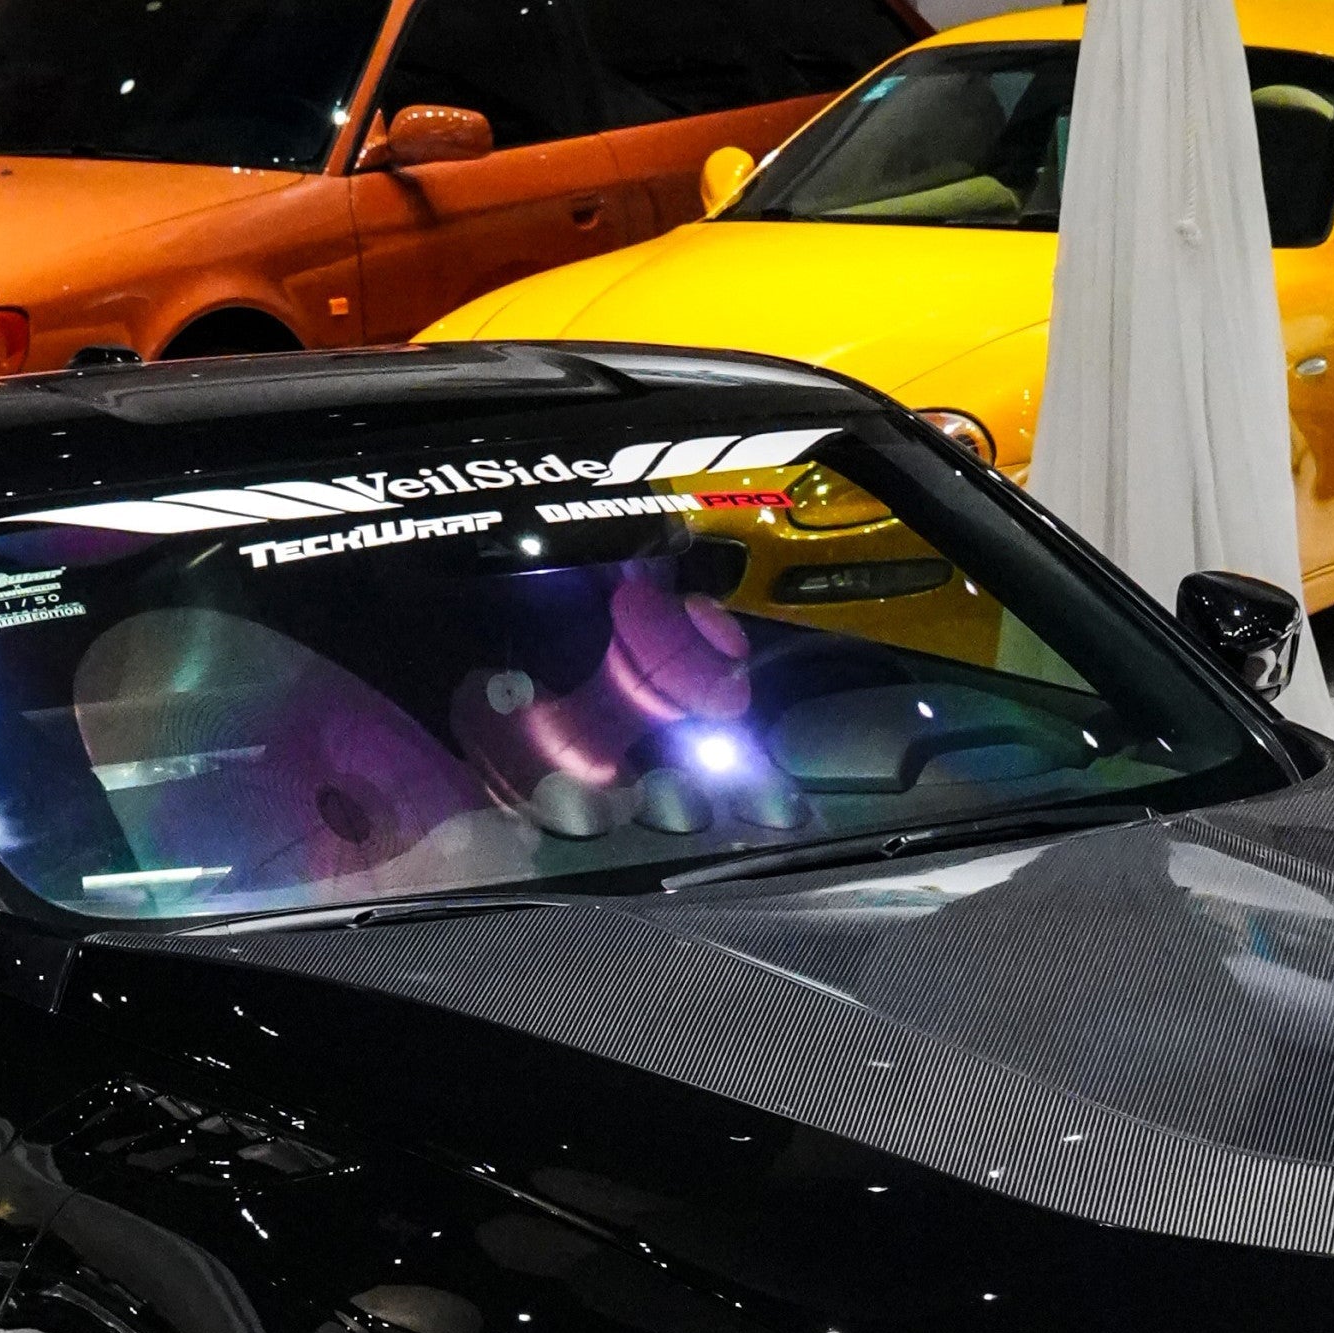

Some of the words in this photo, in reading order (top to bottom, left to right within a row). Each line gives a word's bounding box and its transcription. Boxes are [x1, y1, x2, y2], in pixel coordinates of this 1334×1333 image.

[331, 454, 612, 504] VeilSide
[34, 593, 60, 605] 50
[32, 605, 87, 622] EDITION
